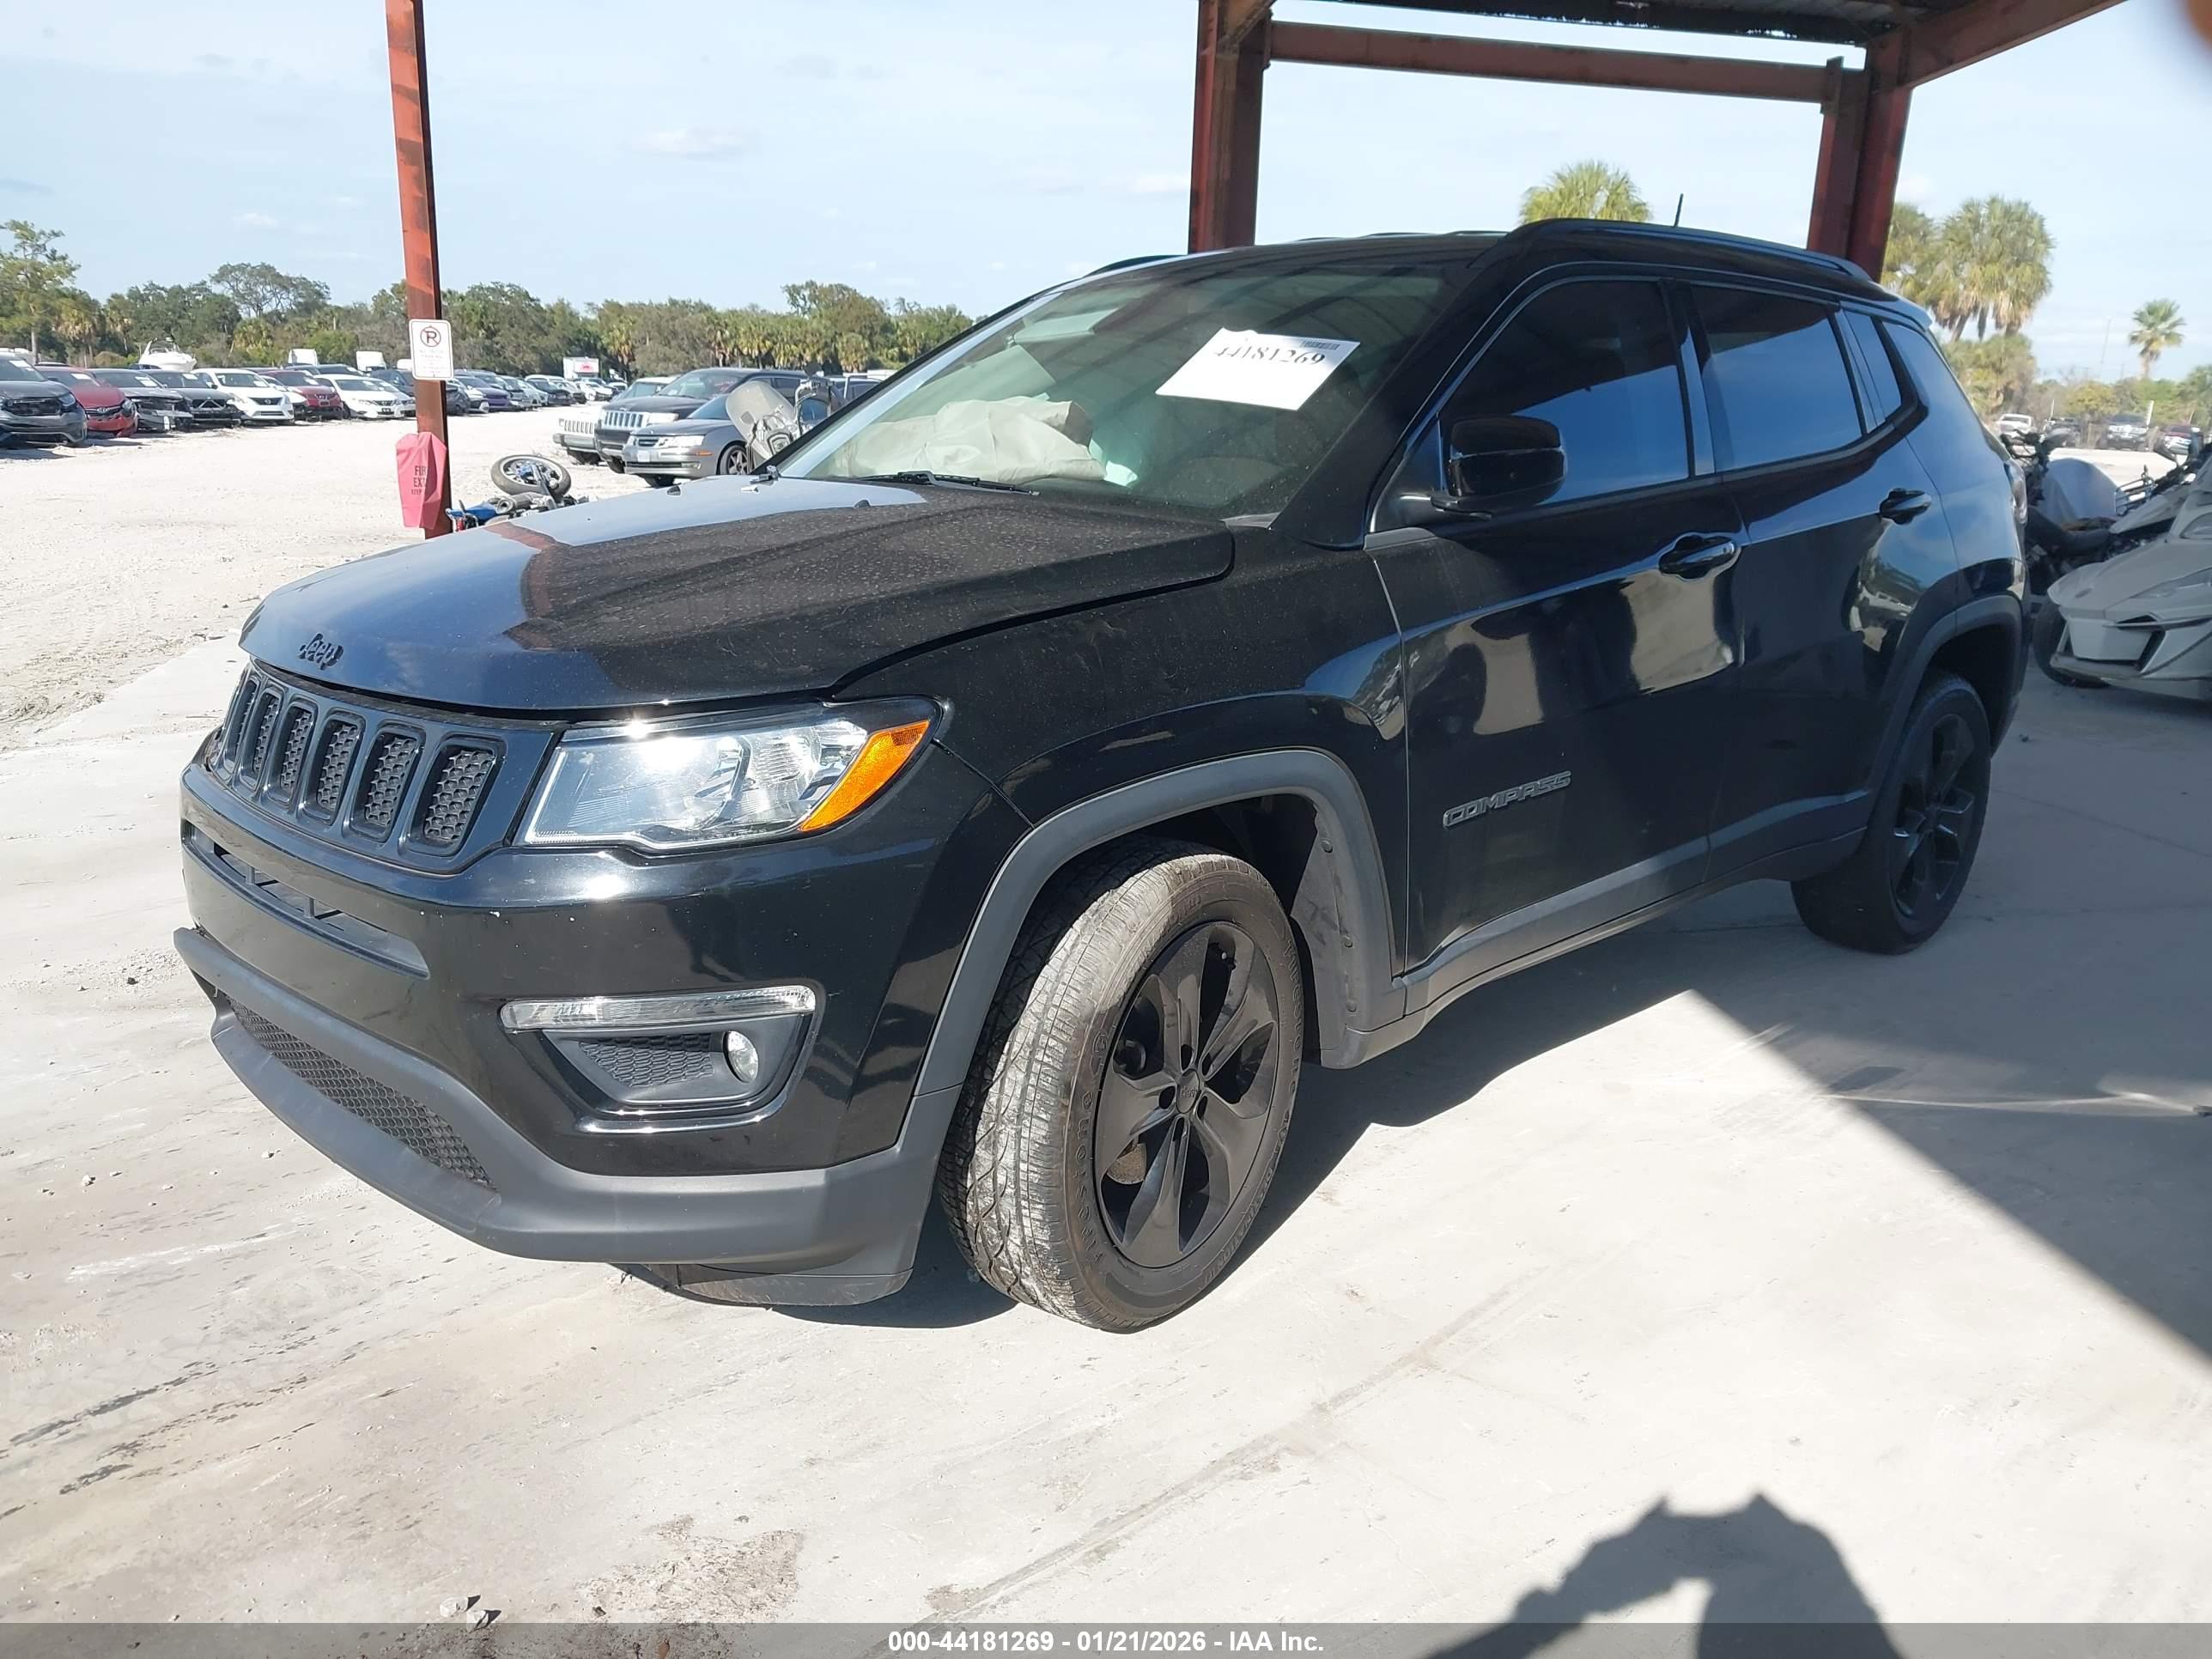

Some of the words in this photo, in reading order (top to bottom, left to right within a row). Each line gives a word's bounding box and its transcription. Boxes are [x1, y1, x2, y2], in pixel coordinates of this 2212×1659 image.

[415, 465, 426, 476] FIR
[298, 633, 343, 671] Jeep
[1443, 770, 1572, 828] COMPASS
[1073, 1090, 1104, 1267] Firestone
